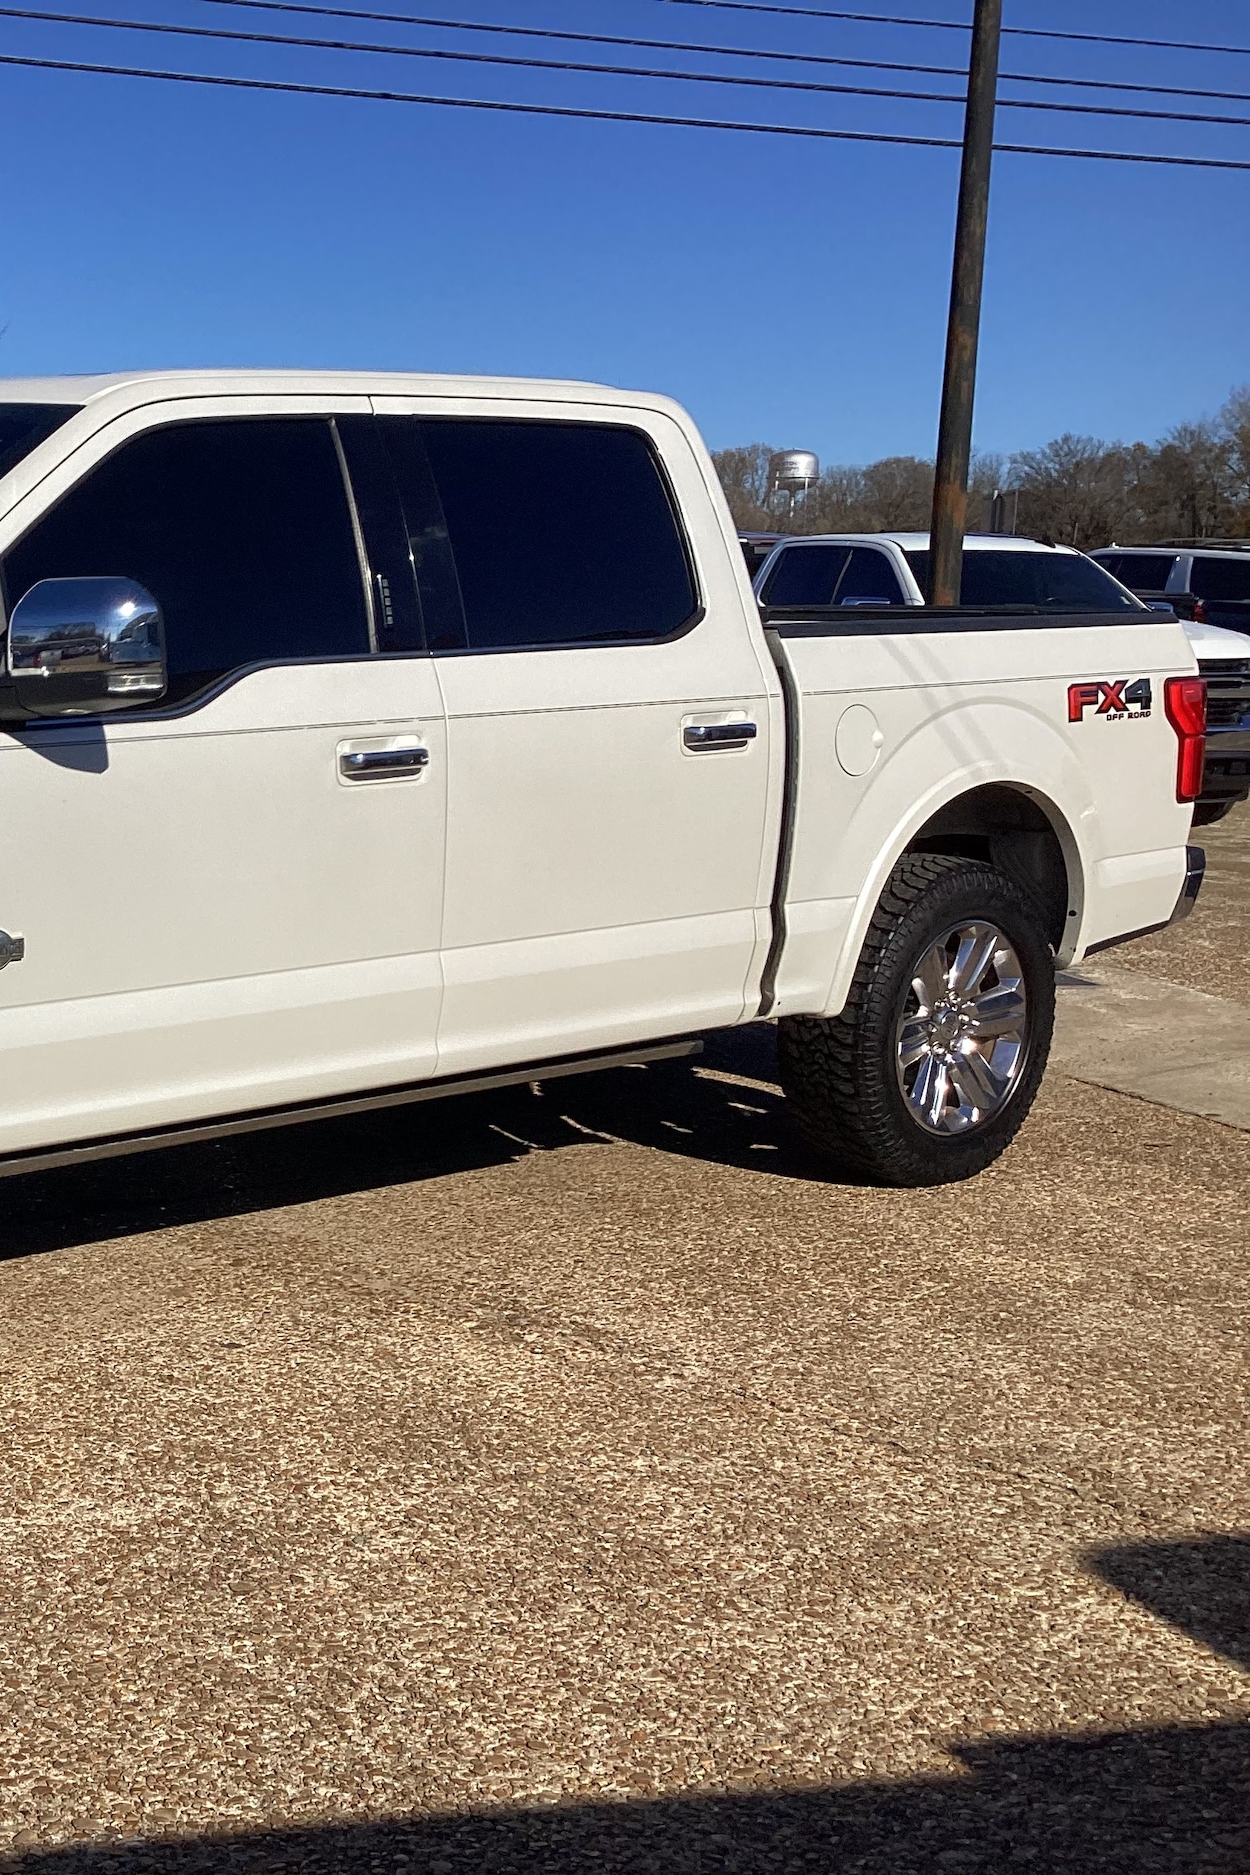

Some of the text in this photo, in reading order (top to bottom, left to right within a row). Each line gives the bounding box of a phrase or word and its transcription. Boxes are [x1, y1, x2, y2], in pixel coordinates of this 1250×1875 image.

[1067, 678, 1152, 723] FX4
[1106, 711, 1152, 721] OFF ROAD
